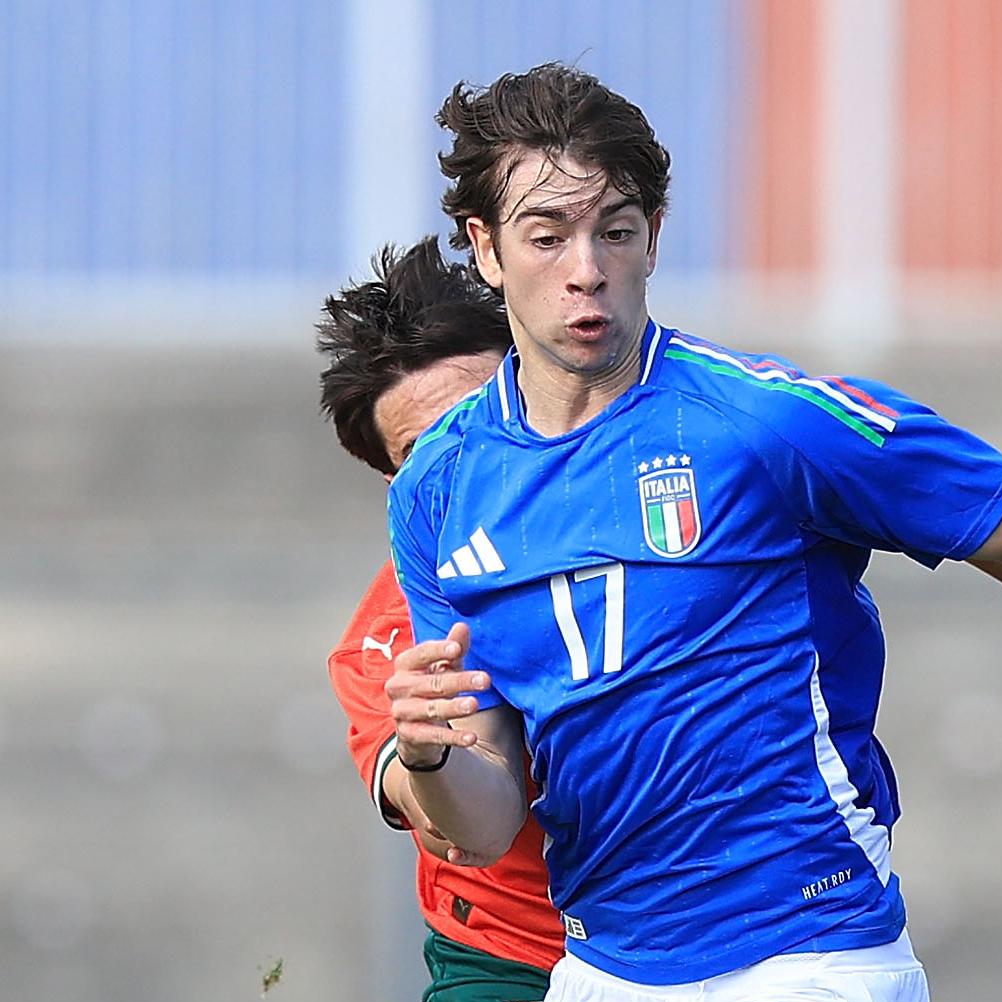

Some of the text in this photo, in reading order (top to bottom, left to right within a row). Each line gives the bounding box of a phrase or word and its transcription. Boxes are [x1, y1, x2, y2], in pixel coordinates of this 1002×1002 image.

[644, 475, 690, 498] ITALIA
[550, 562, 625, 681] 17
[802, 868, 853, 900] HEAT.RDY
